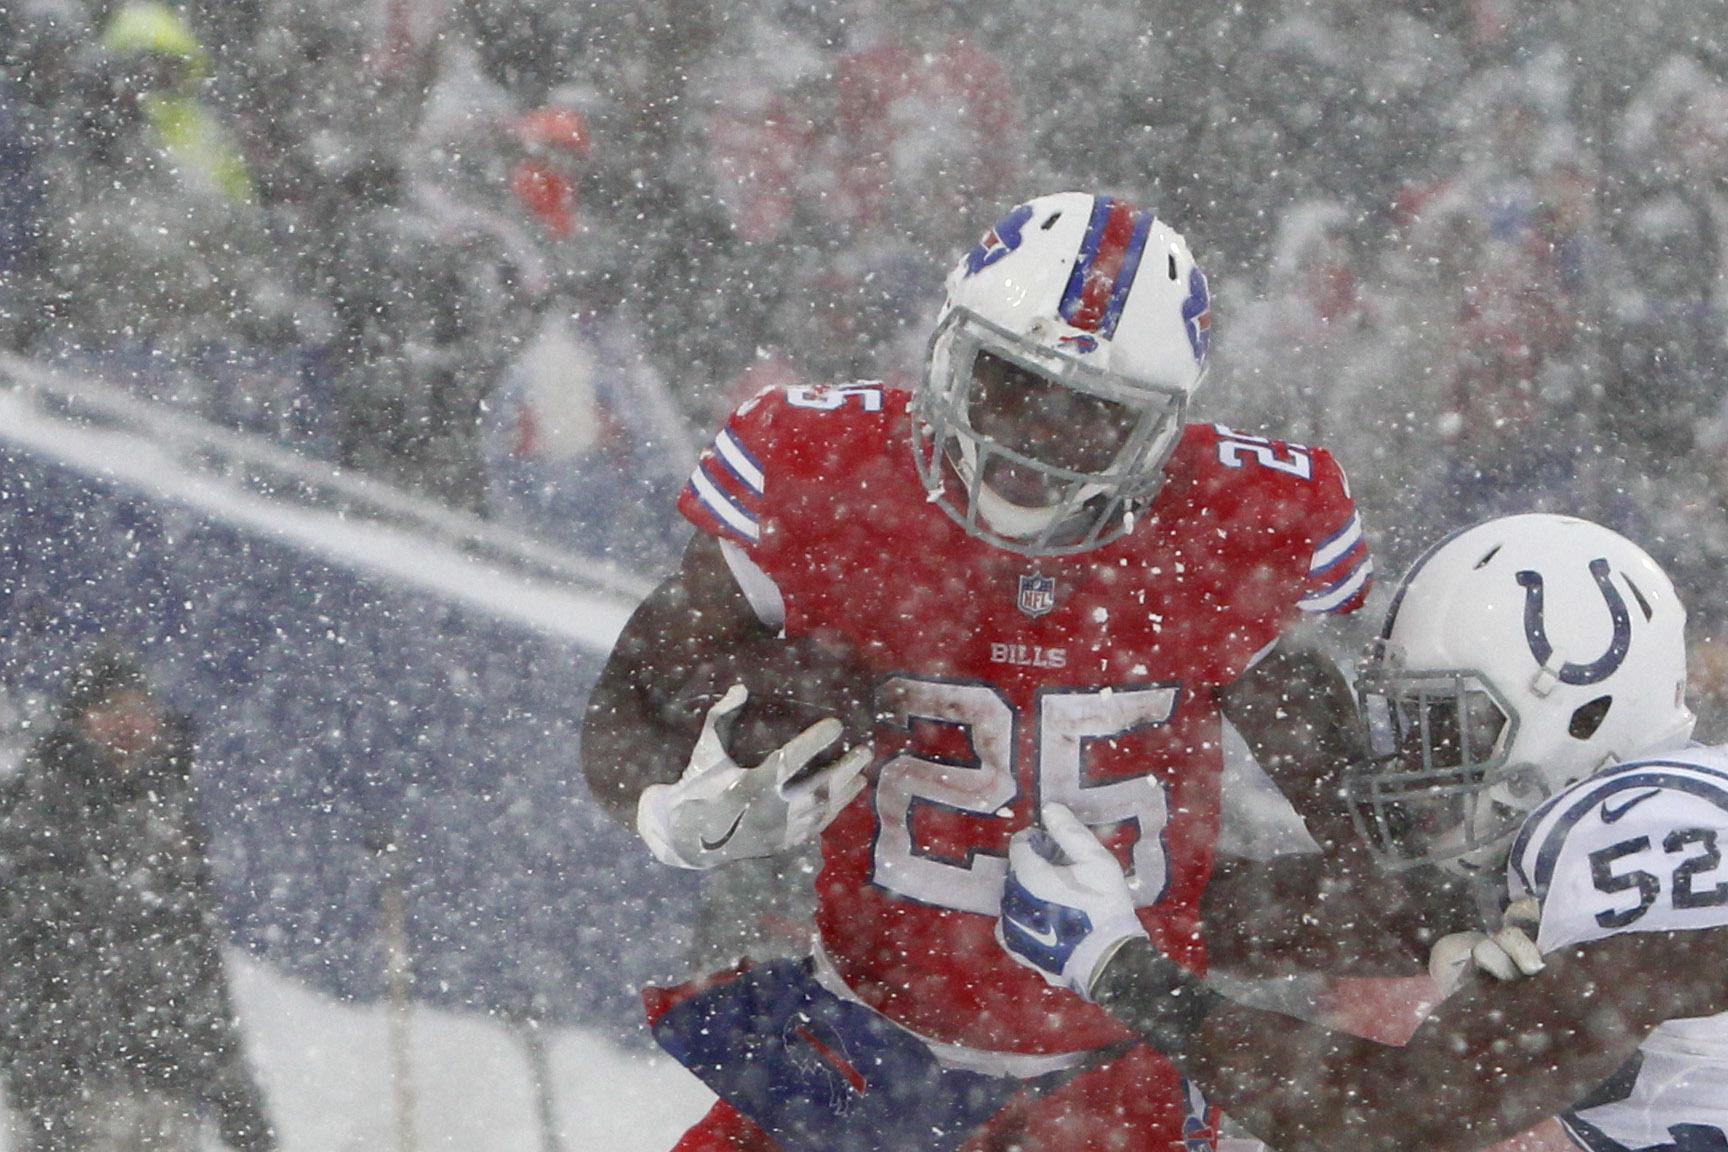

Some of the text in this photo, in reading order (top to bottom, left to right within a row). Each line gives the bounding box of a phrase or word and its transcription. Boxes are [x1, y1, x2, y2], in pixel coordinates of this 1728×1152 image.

[785, 380, 884, 412] 5
[1214, 424, 1312, 480] 2
[990, 642, 1067, 668] BILLS
[872, 673, 1182, 917] 25
